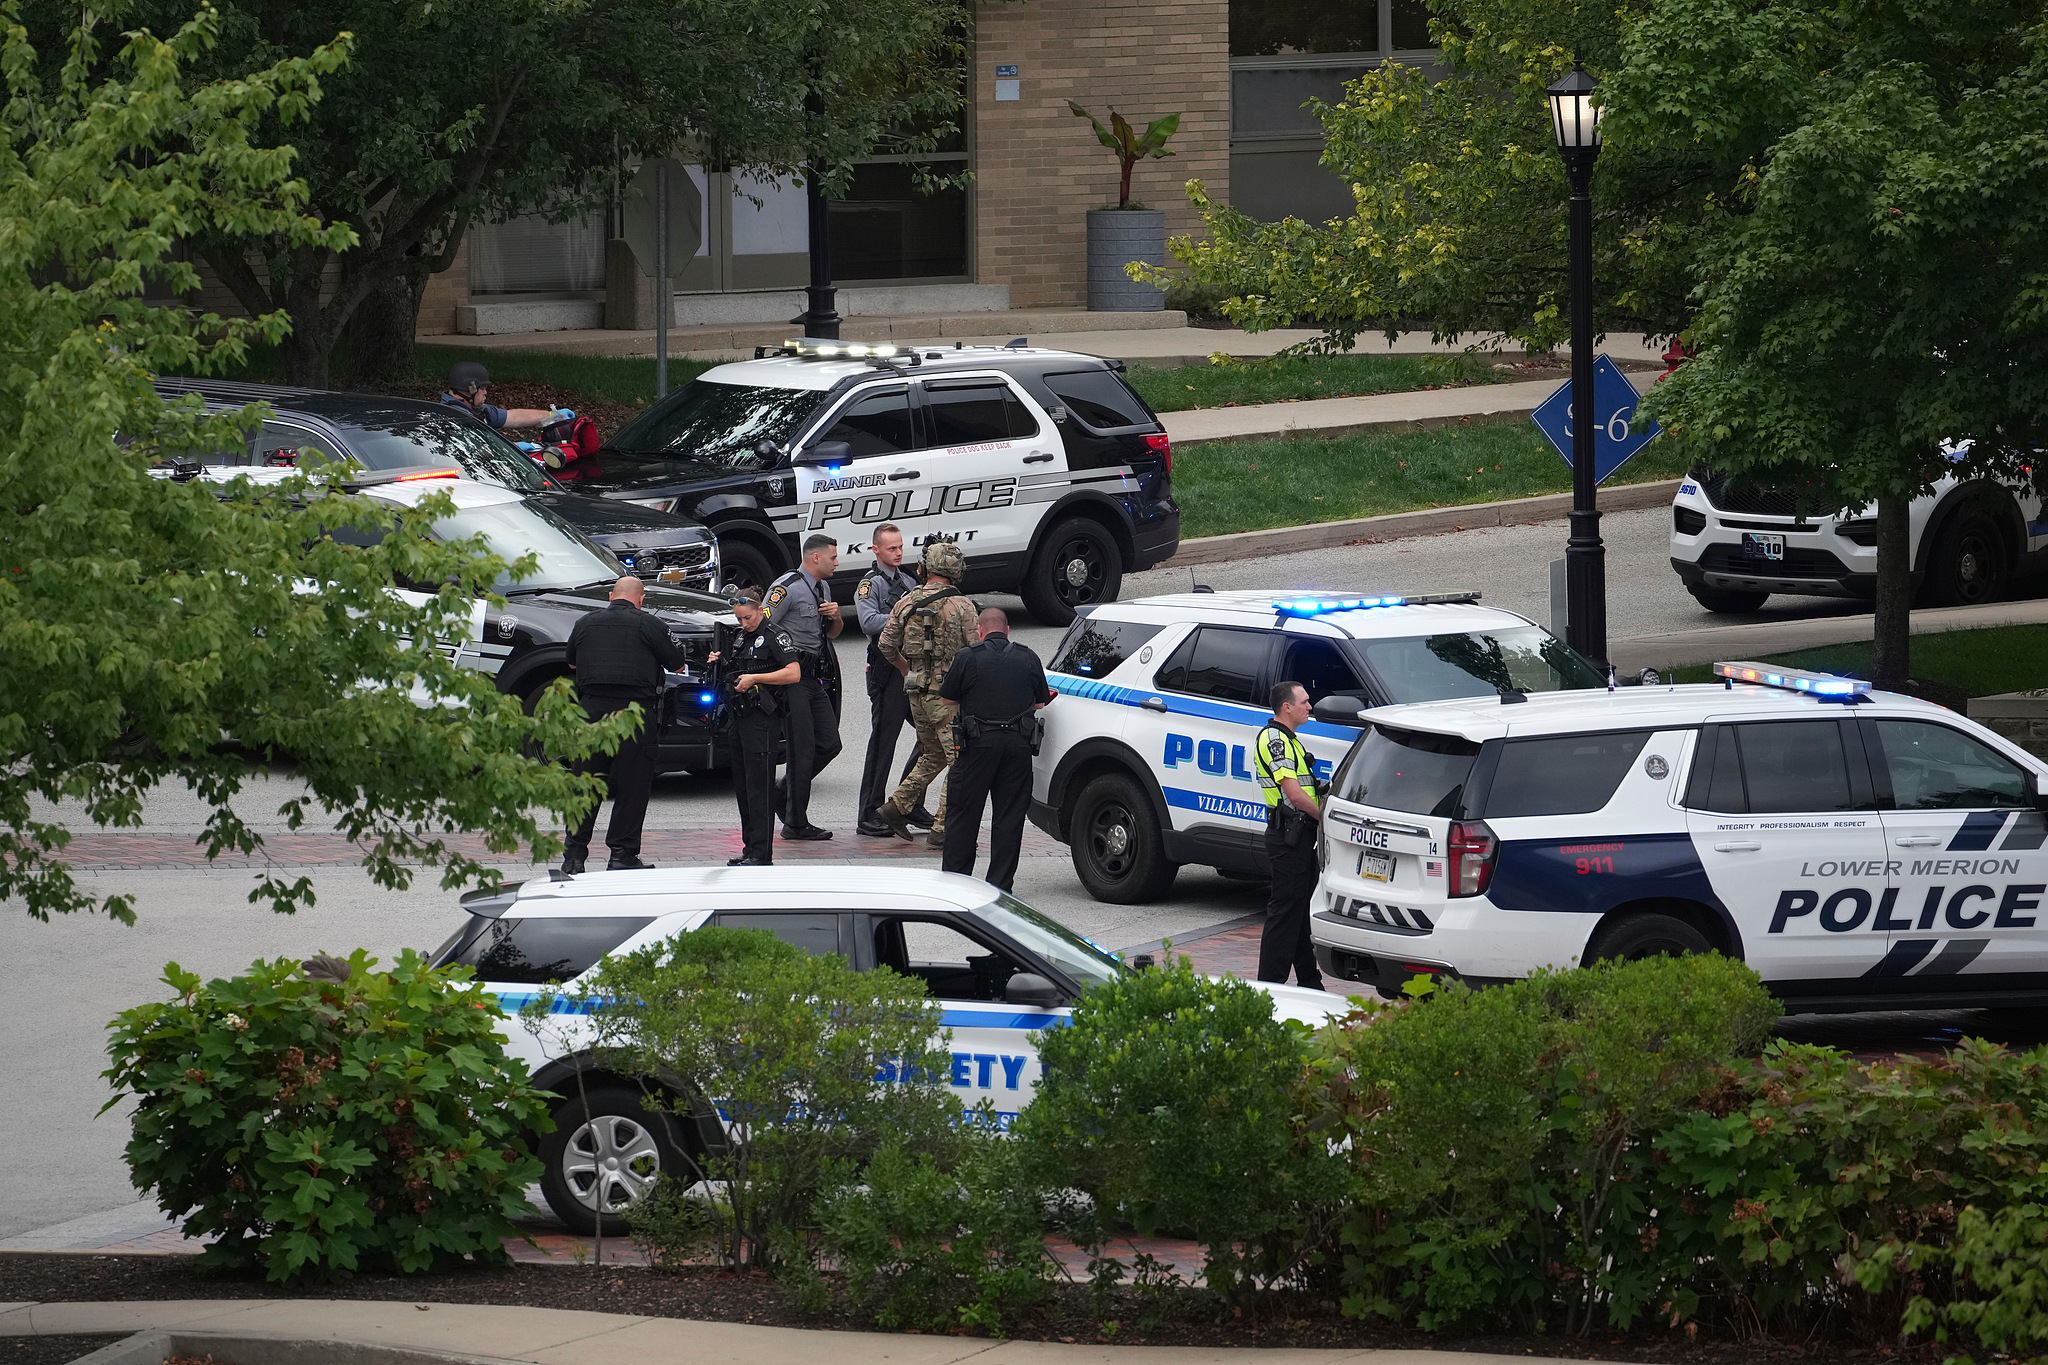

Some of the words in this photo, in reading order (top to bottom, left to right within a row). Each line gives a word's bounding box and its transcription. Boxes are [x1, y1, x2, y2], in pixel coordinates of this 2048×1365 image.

[947, 447, 968, 455] POLICE
[981, 443, 995, 451] KEEP
[995, 442, 1012, 450] BACK
[812, 473, 887, 493] RADNOR
[808, 477, 1017, 531] POLICE
[912, 530, 978, 547] UIT
[1163, 733, 1333, 784] POLE
[1197, 795, 1267, 820] VILLANOVA
[1717, 823, 1755, 831] INTEGRITY
[1760, 821, 1829, 829] PROFESSIONALISM
[1350, 827, 1389, 848] POLICE
[1429, 842, 1437, 855] 14
[1560, 842, 1625, 854] EMERGENCY
[1576, 856, 1614, 875] 911
[1800, 860, 1903, 877] LOWER
[1910, 859, 2021, 876] MERION
[1767, 884, 2047, 934] POLICE
[872, 1052, 1028, 1091] SETY
